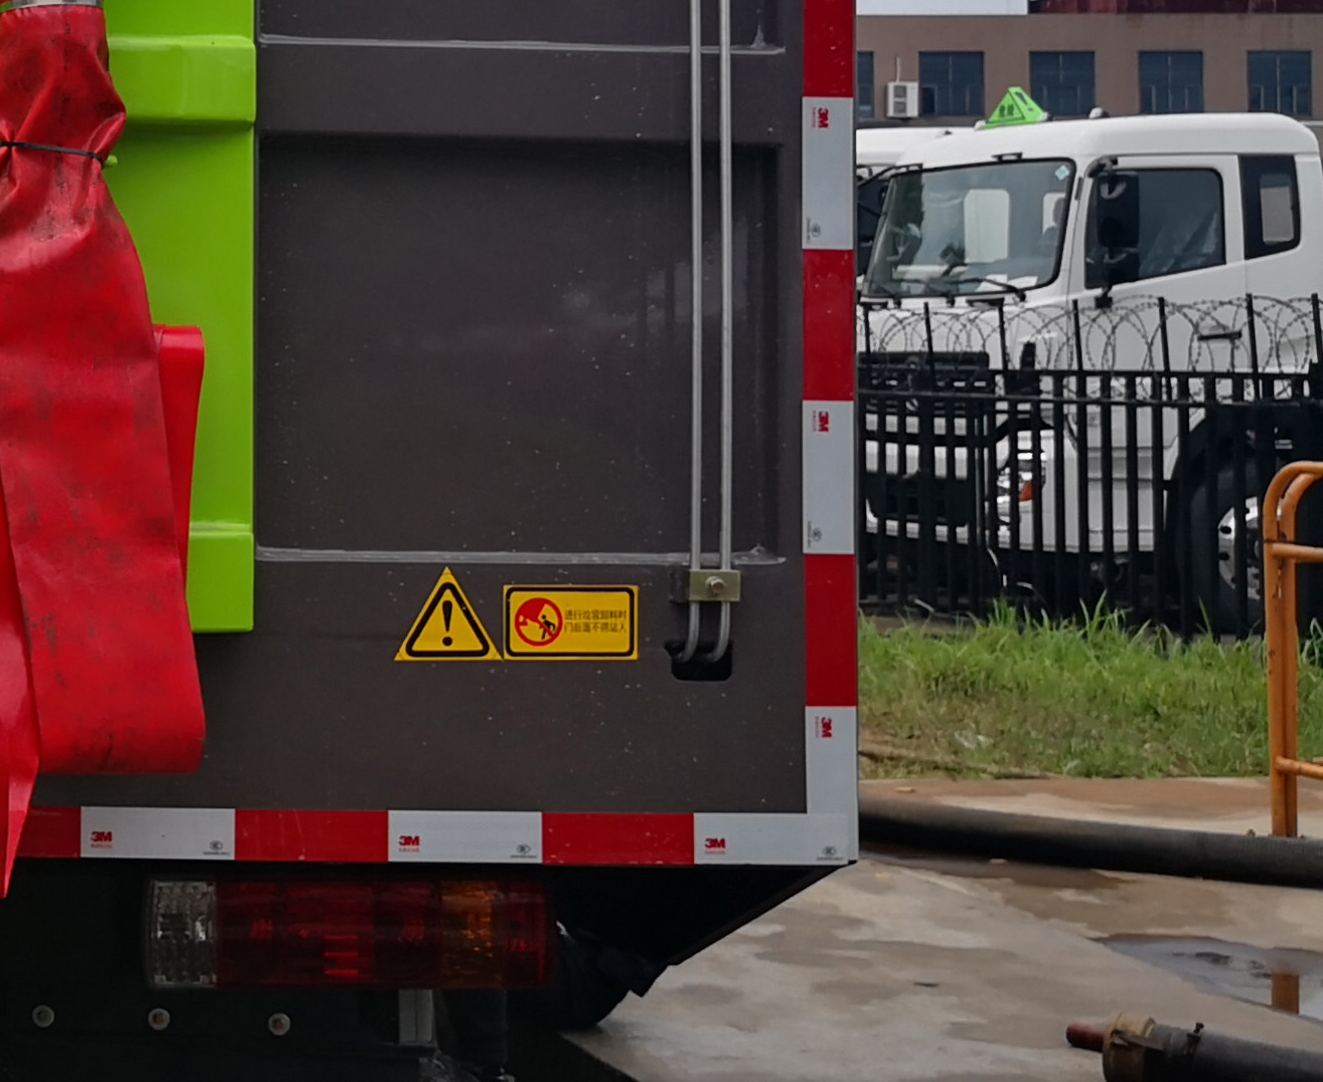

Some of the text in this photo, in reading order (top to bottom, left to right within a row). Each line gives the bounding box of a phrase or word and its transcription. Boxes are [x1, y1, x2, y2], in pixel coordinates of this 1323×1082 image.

[817, 107, 829, 129] 3M
[818, 411, 829, 433] 3M
[821, 717, 833, 738] 3M
[91, 831, 113, 843] 3M
[398, 835, 420, 847] 3M
[704, 838, 726, 849] 3M
